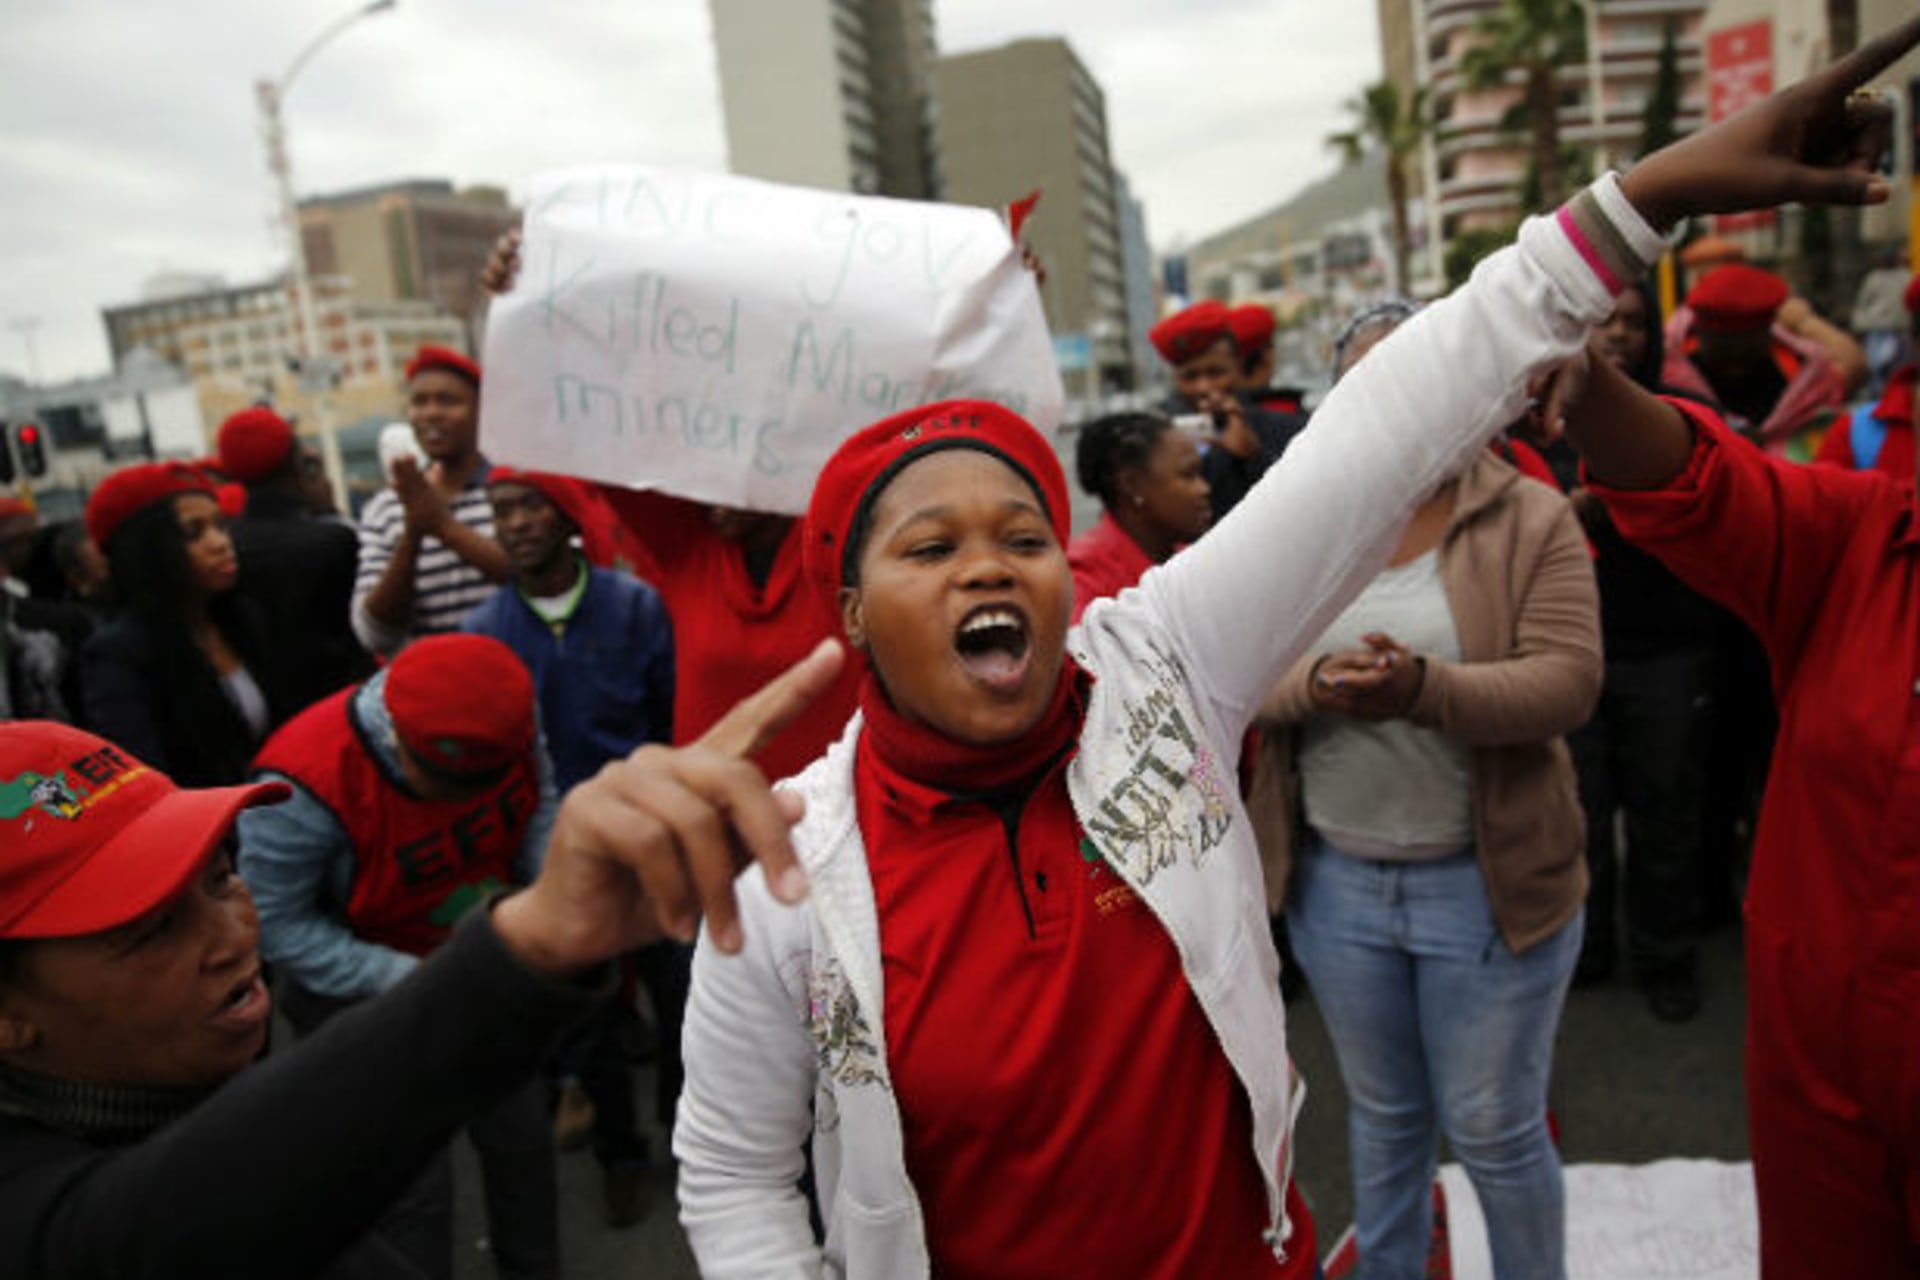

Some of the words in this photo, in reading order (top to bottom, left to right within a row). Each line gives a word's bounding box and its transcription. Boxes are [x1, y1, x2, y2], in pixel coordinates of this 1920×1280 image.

[540, 177, 748, 238] ANC
[542, 241, 738, 374] Killed
[555, 373, 784, 475] miners
[396, 777, 526, 886] EFF
